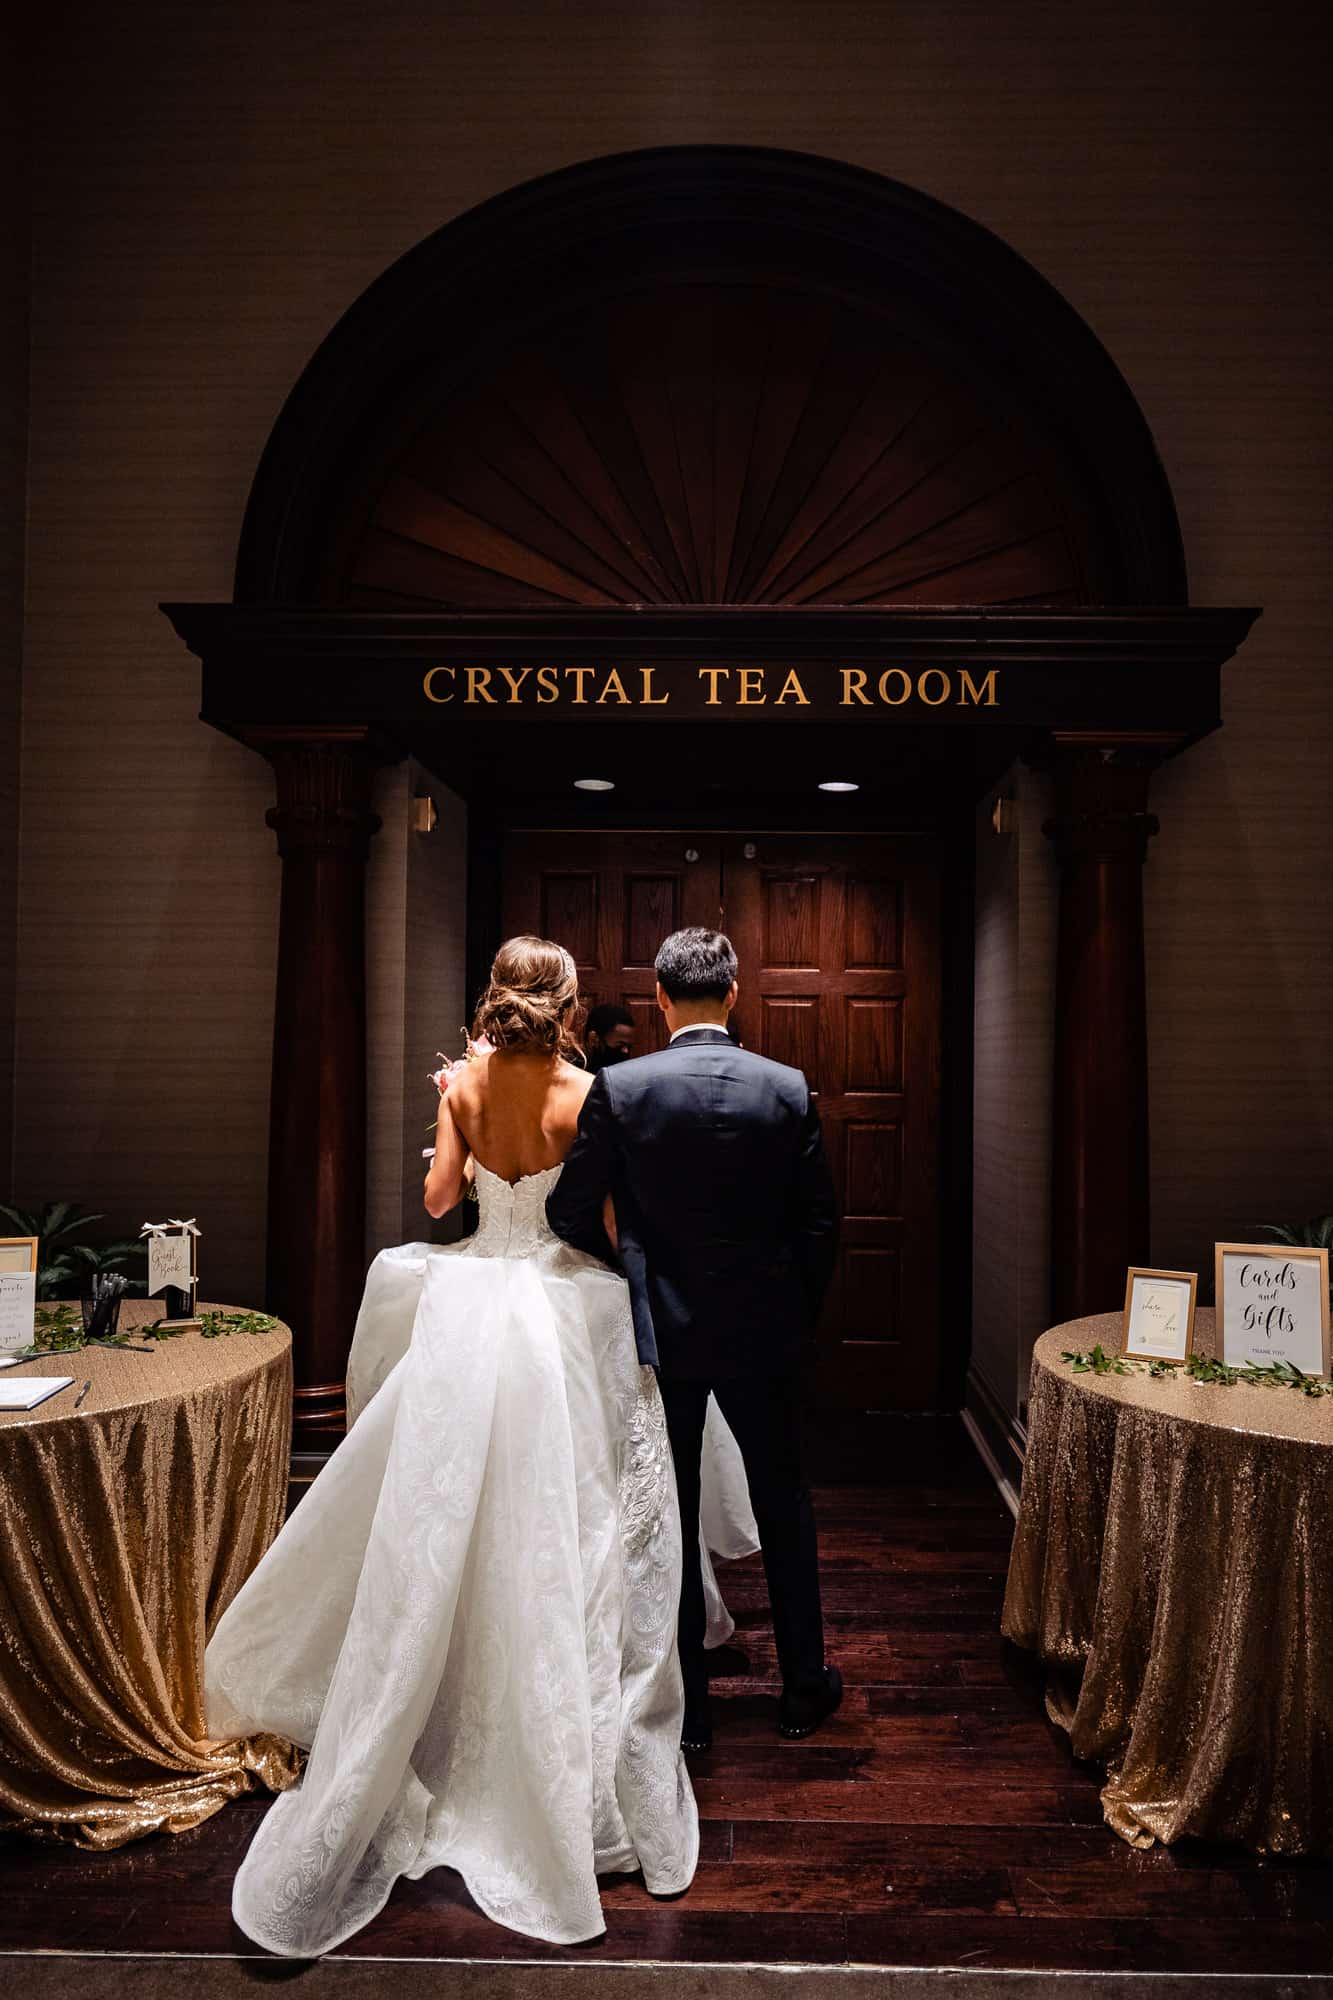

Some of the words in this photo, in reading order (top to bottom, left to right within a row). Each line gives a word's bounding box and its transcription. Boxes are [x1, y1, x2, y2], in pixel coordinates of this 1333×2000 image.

[423, 667, 669, 705] CRYSTAL
[698, 668, 811, 706] TEA
[839, 668, 1001, 707] ROOM
[153, 1256, 186, 1278] Book
[1240, 1263, 1298, 1290] Cards
[1258, 1290, 1279, 1302] and
[1240, 1303, 1295, 1338] Gifts
